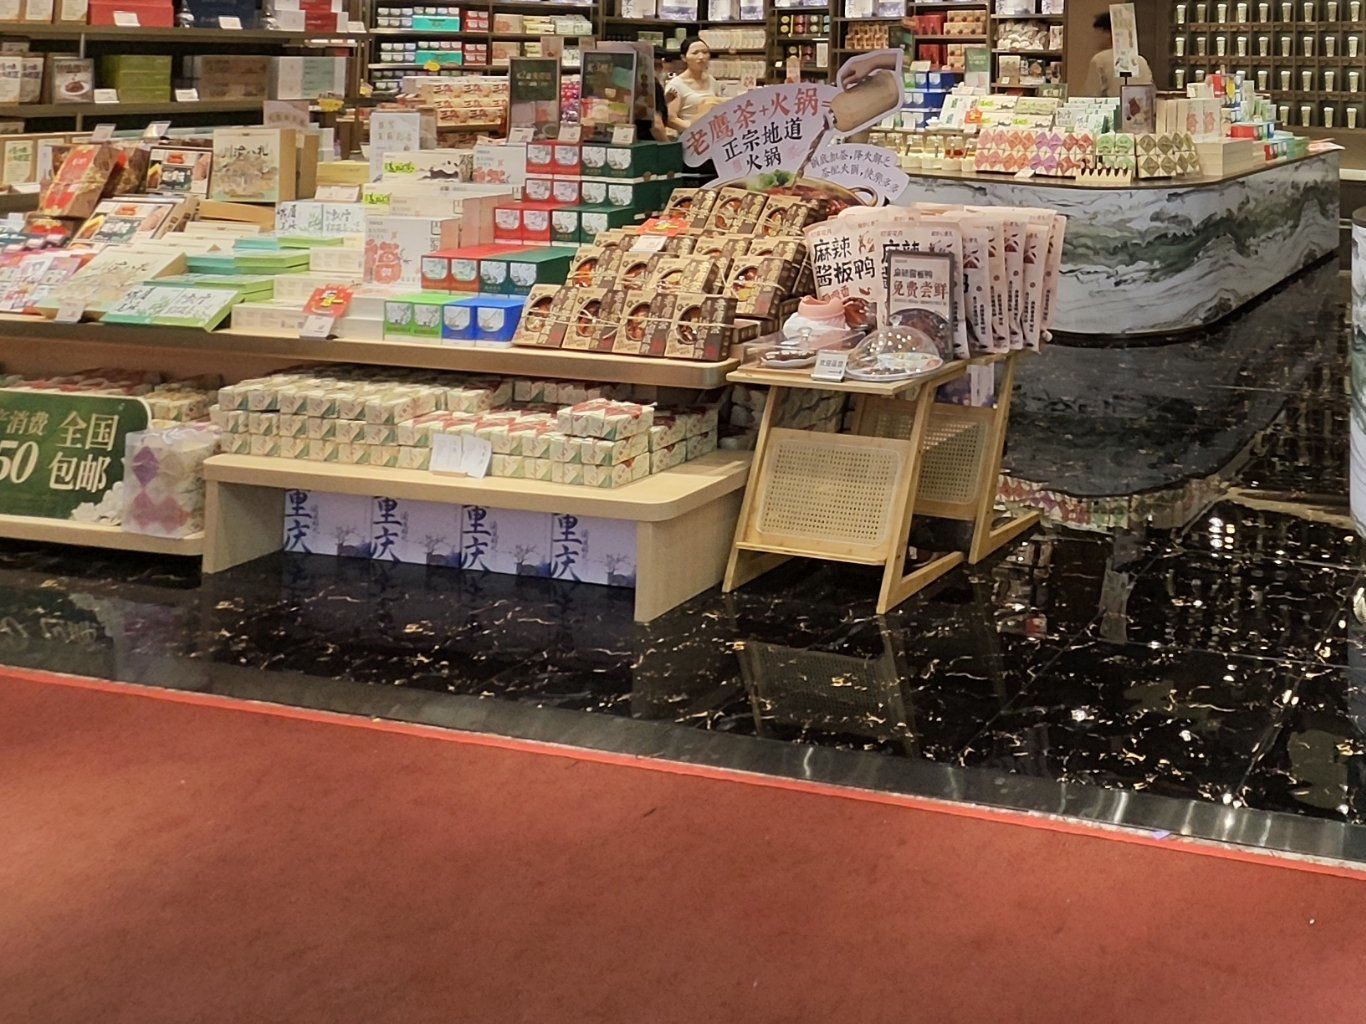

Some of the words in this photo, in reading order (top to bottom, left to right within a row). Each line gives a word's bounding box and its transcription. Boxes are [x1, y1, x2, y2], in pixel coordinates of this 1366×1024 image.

[721, 118, 803, 163] 正宗地道
[745, 146, 782, 173] 火锅
[813, 236, 852, 264] 麻辣
[815, 256, 876, 288] 酱板鸭
[892, 279, 948, 300] 免费尝鲜
[56, 410, 119, 452] 全国
[48, 451, 112, 494] 包邮
